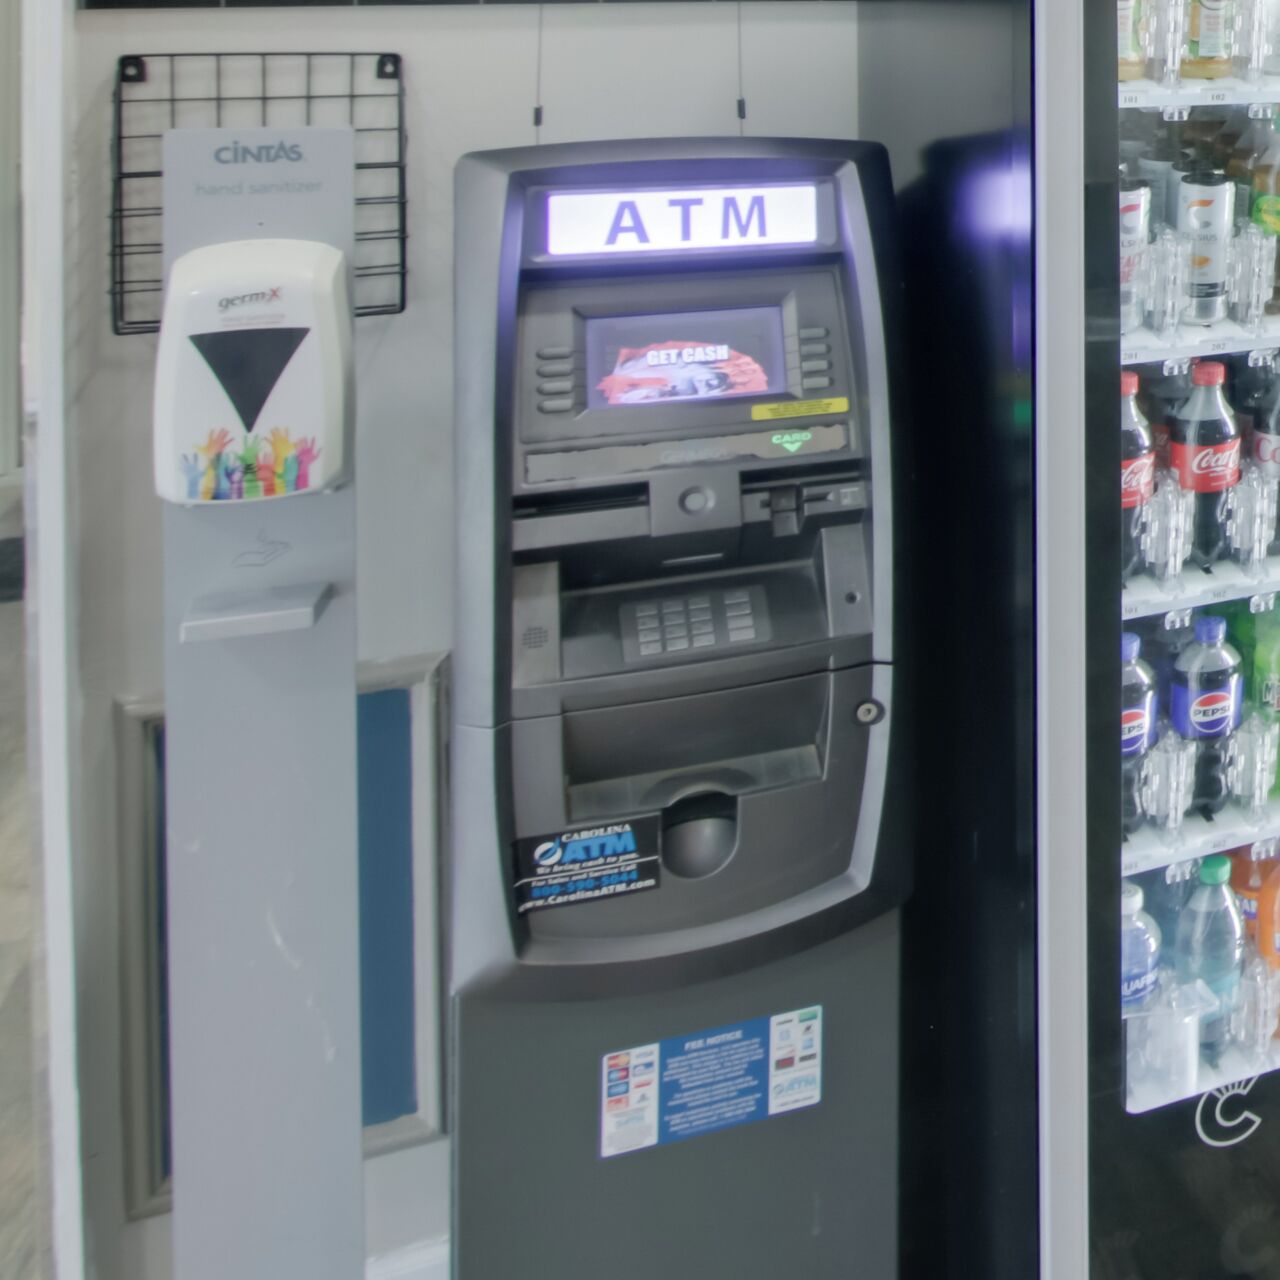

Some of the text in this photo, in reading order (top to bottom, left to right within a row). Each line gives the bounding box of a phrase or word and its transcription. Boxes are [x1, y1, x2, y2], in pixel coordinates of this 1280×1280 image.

[214, 140, 303, 165] CINTAS
[195, 180, 323, 197] hand sanitizer
[605, 195, 767, 246] ATM
[646, 344, 729, 366] GET CASH
[772, 431, 812, 444] CARD
[1193, 704, 1231, 718] PEPSI
[561, 823, 632, 843] CAROLINA
[561, 831, 637, 863] ATM
[684, 1029, 743, 1051] FEE NOTICE
